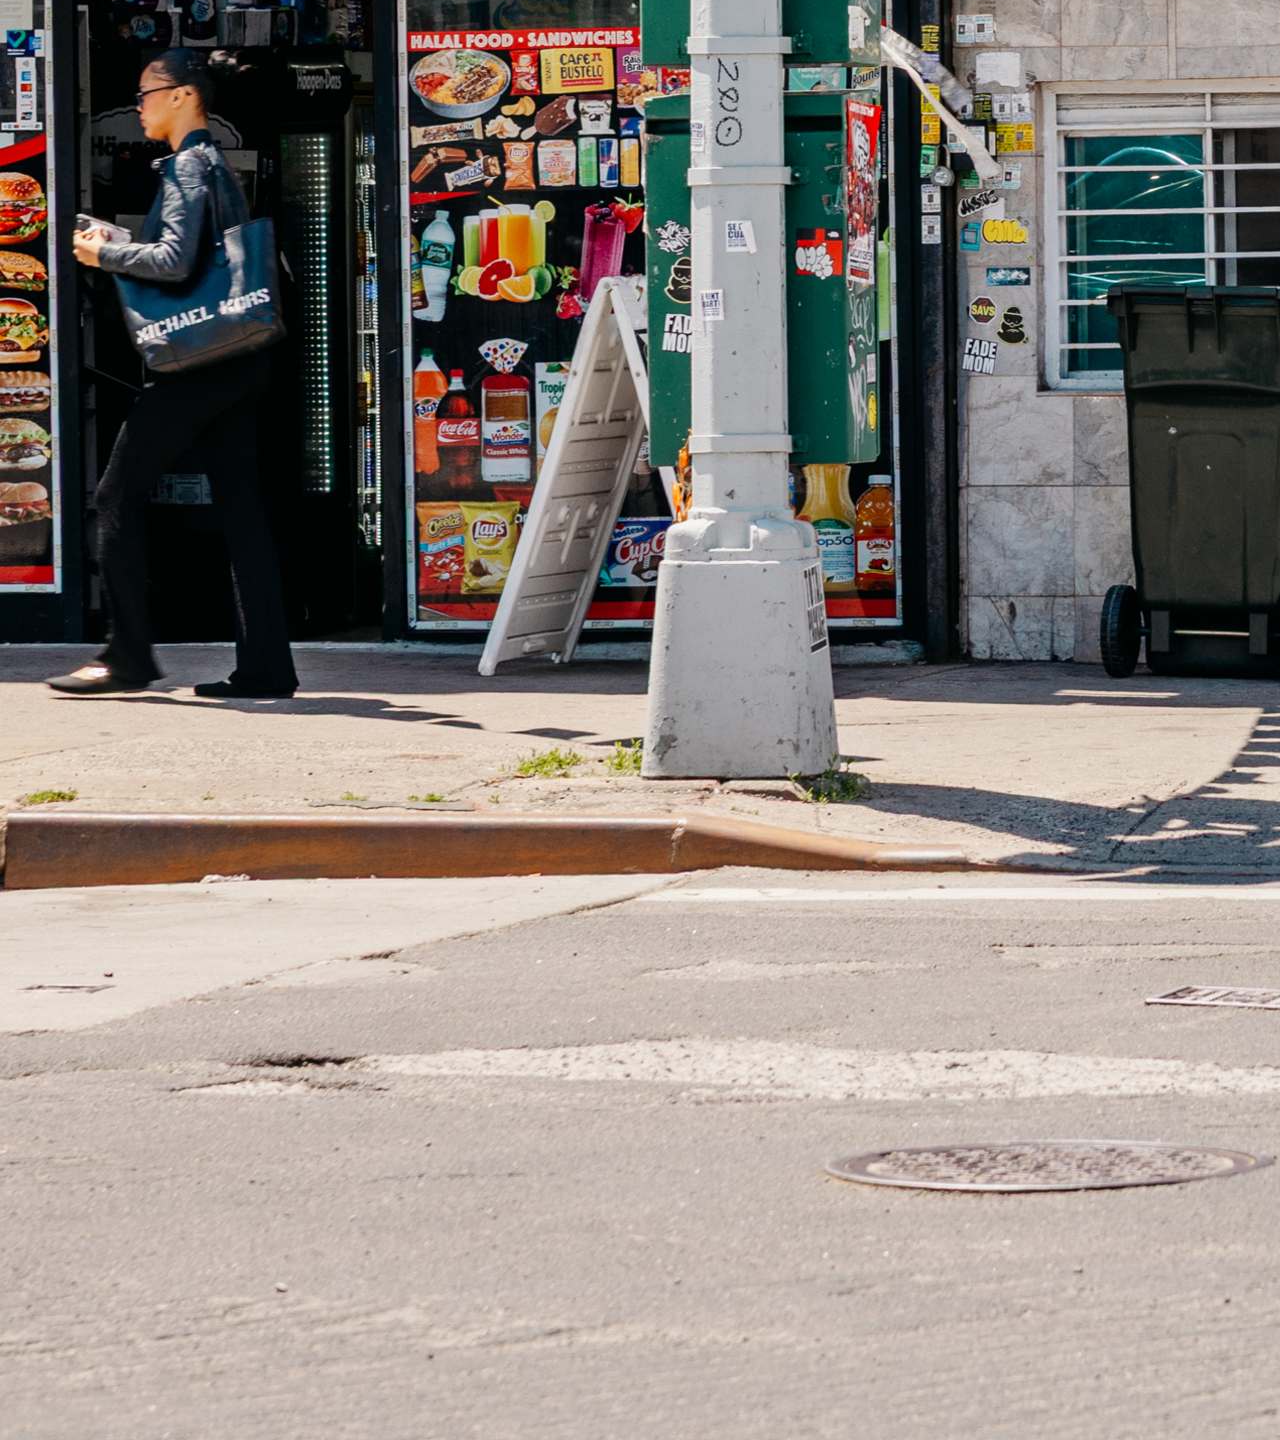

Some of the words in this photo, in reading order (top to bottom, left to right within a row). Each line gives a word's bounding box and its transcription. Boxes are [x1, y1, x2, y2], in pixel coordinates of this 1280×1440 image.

[410, 35, 462, 50] HALAL
[466, 34, 514, 48] FOOD
[527, 31, 634, 48] SANDWICHES
[218, 287, 271, 315] KORS
[970, 304, 996, 317] SAVS
[965, 338, 997, 359] FADE
[962, 354, 996, 375] MOM
[491, 432, 524, 441] Wonder
